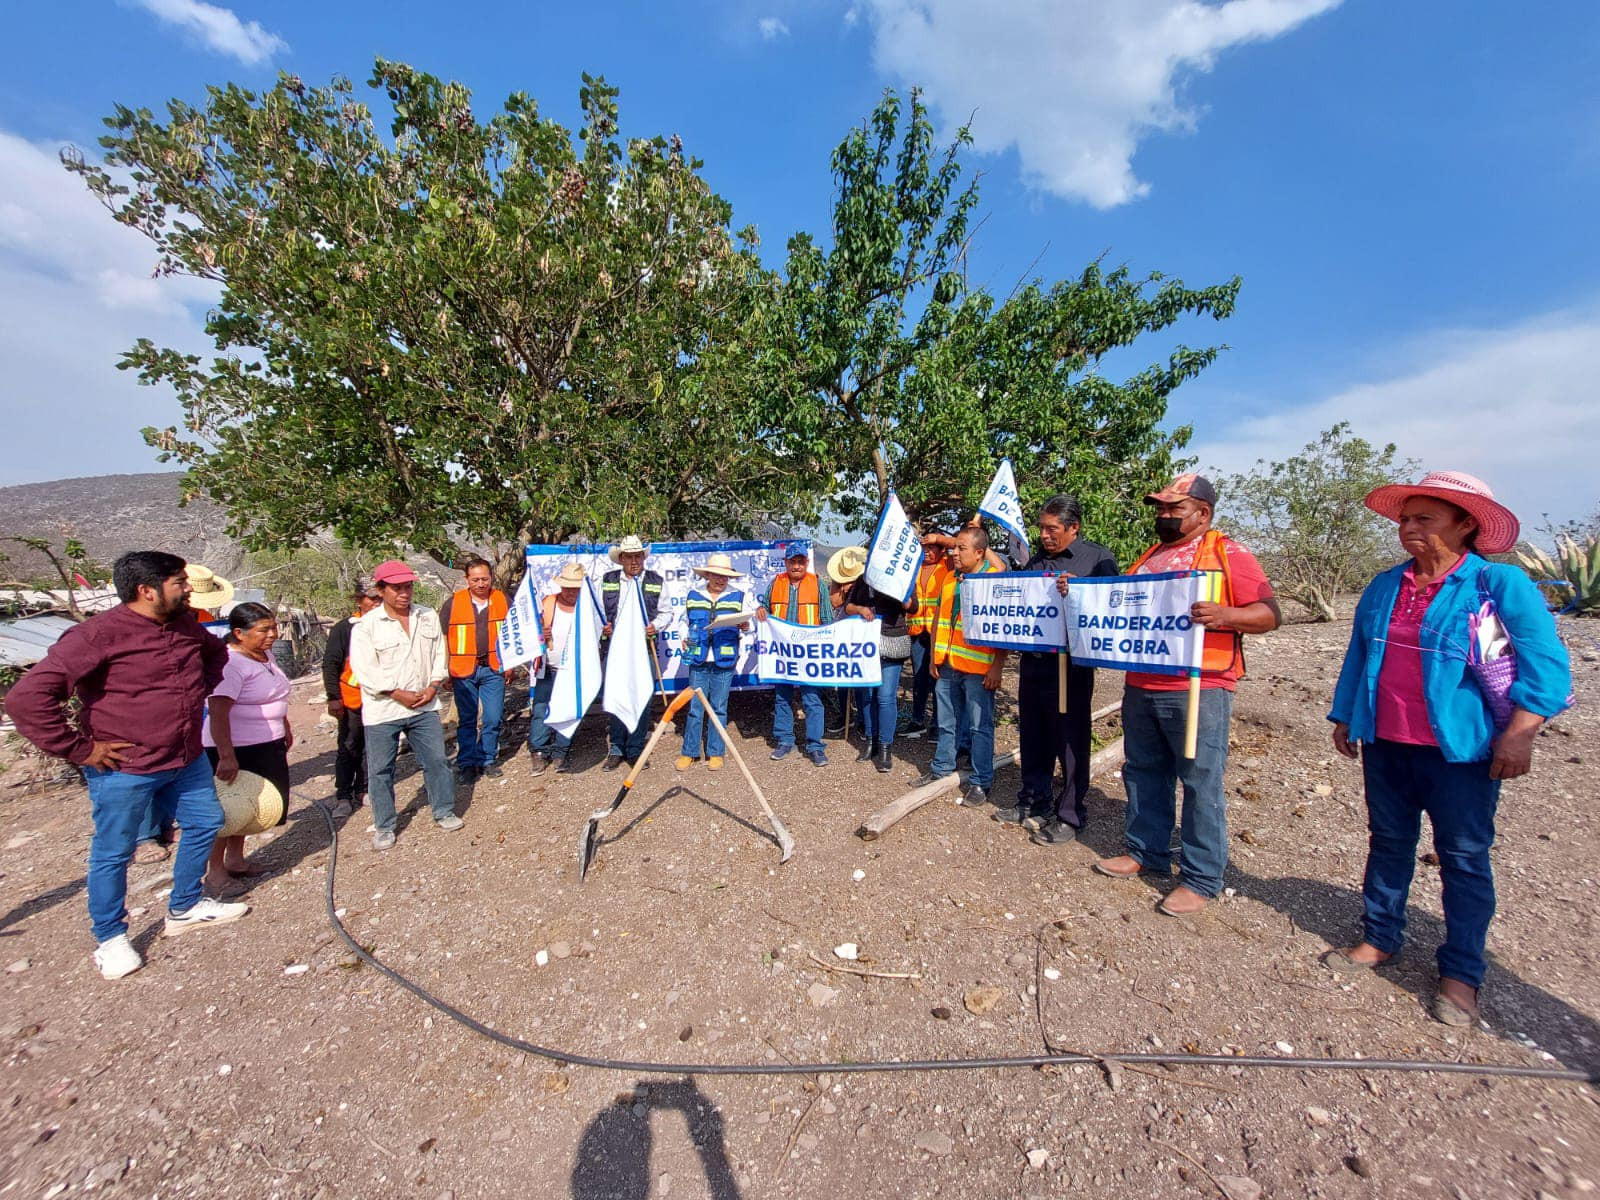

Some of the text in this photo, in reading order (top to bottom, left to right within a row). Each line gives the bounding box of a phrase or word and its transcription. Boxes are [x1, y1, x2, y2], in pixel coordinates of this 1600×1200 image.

[902, 555, 914, 573] DE
[665, 569, 687, 582] DE
[971, 605, 1059, 619] BANDERAZO
[982, 622, 1044, 638] DE OBRA
[1078, 614, 1194, 632] BANDERAZO
[757, 640, 877, 659] BANDERAZO
[1091, 636, 1171, 656] DE OBRA
[775, 659, 863, 678] DE OBRA
